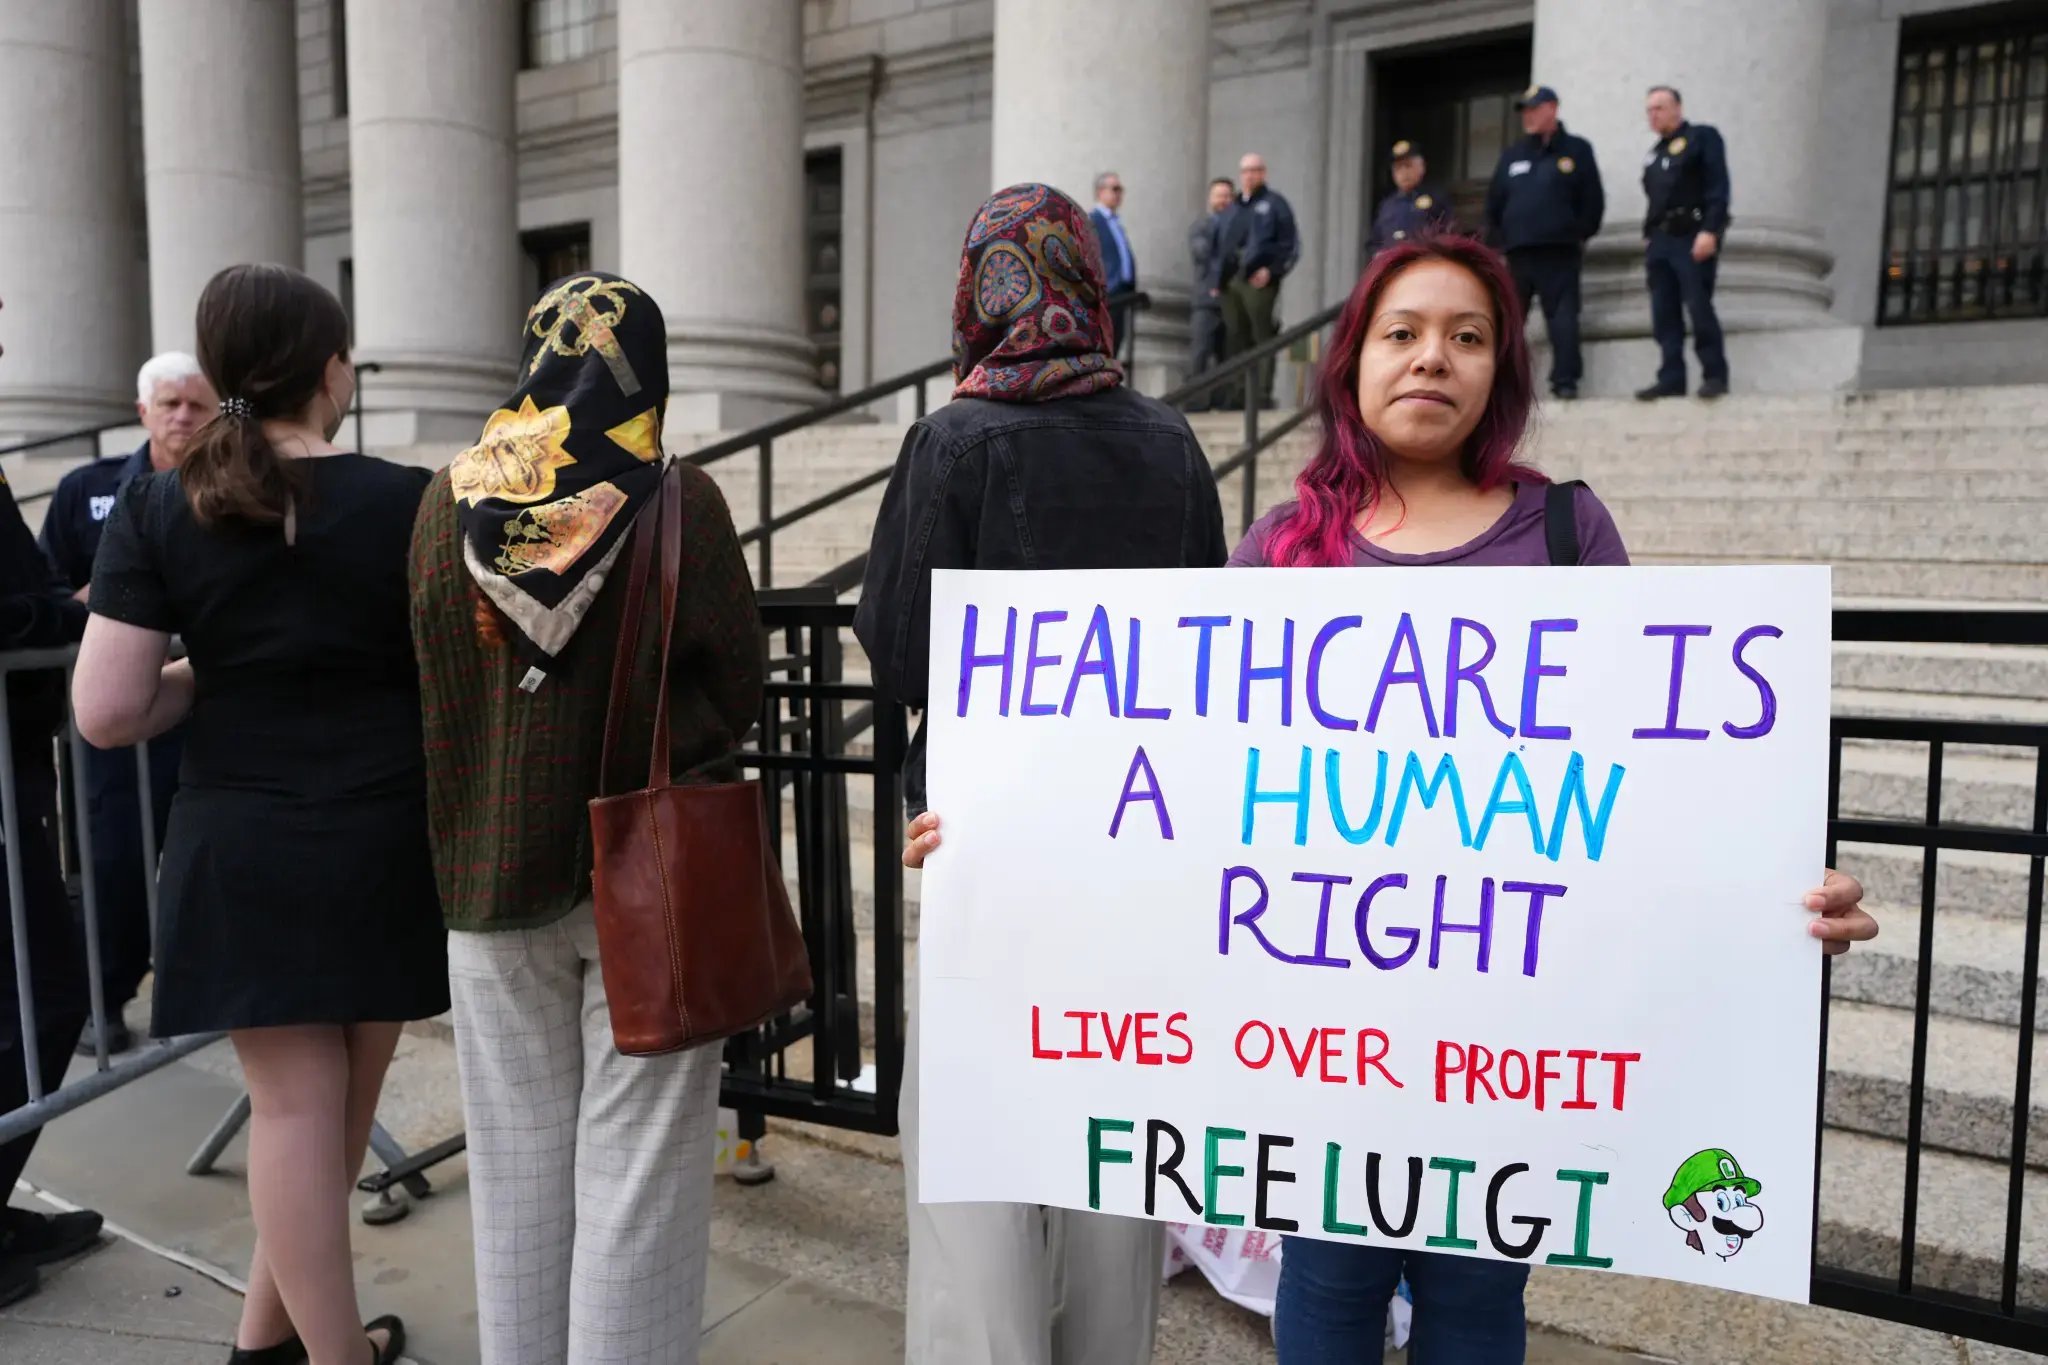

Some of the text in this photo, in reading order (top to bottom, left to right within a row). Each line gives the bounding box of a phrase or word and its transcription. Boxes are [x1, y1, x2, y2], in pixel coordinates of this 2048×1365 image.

[958, 604, 1783, 740] HEALTHCARE IS
[1109, 745, 1626, 863] A HUMAN
[1219, 866, 1567, 977] RIGHT
[1032, 1006, 1641, 1111] LIVES OVER PROFIT
[1722, 1162, 1734, 1176] L
